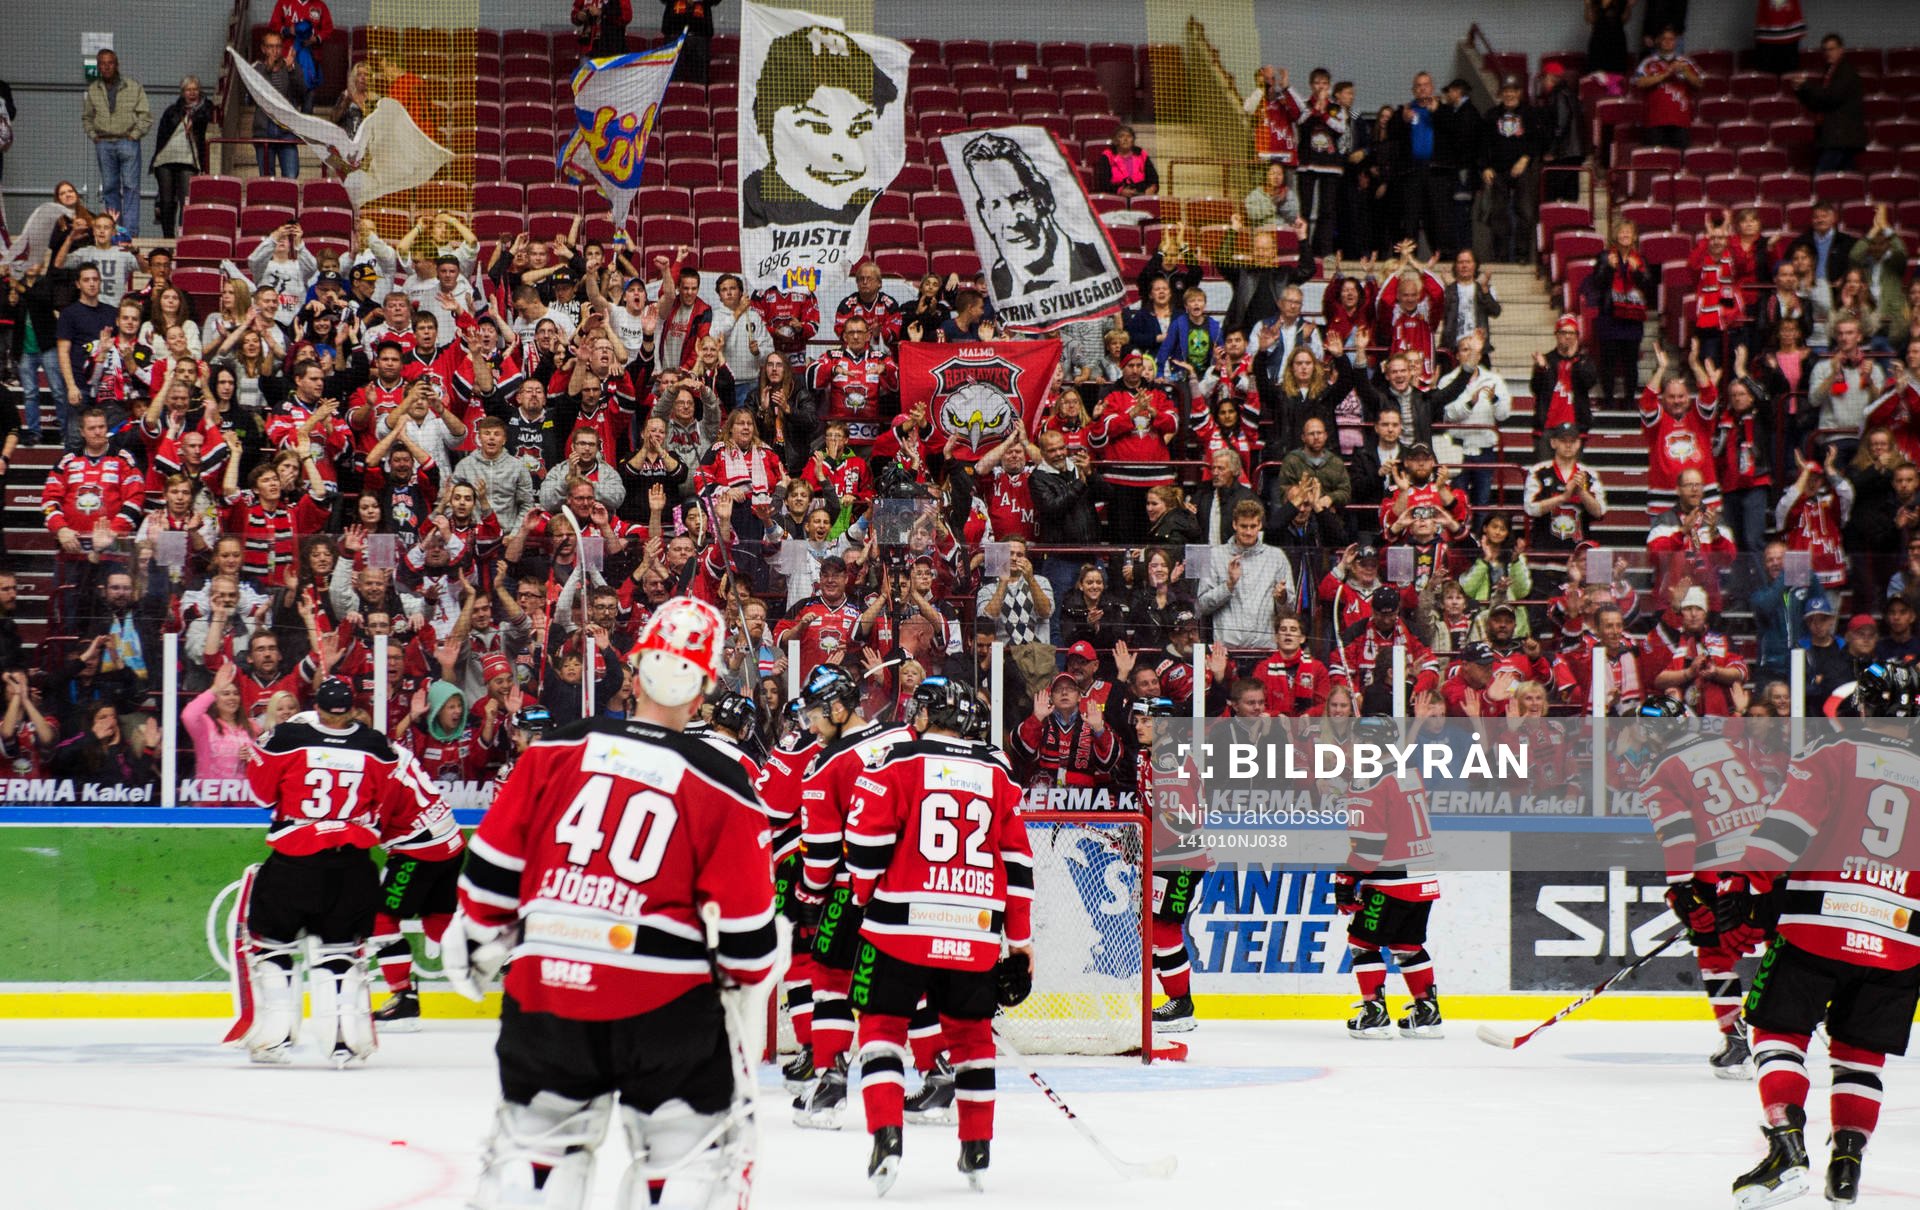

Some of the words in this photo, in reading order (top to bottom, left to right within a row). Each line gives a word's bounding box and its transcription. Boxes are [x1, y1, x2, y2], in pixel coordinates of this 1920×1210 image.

[757, 250, 791, 278] 1996
[994, 302, 1036, 327] TRIK
[1040, 277, 1124, 315] SYLVEGÅRD
[943, 366, 1011, 391] REDHAWKS
[82, 782, 153, 802] Kakel
[300, 768, 365, 820] 37
[1159, 791, 1180, 809] 20
[1212, 789, 1312, 812] KERMA
[1692, 759, 1760, 816] 36
[847, 794, 865, 827] 2
[1519, 795, 1586, 815] Kakel
[1861, 783, 1910, 859] 9
[555, 773, 679, 884] 40
[919, 792, 994, 869] 62
[385, 861, 417, 909] akea
[923, 866, 995, 897] JAKOBS
[1199, 861, 1339, 915] ANTE
[1840, 856, 1909, 895] STORM
[813, 887, 850, 953] akea
[910, 907, 977, 926] Swedbank
[1823, 897, 1890, 921] Swedbank
[931, 938, 972, 957] BRIS
[1204, 920, 1333, 974] TELE
[1846, 930, 1884, 953] BRIS
[540, 959, 593, 984] BRIS
[852, 943, 877, 1005] ake
